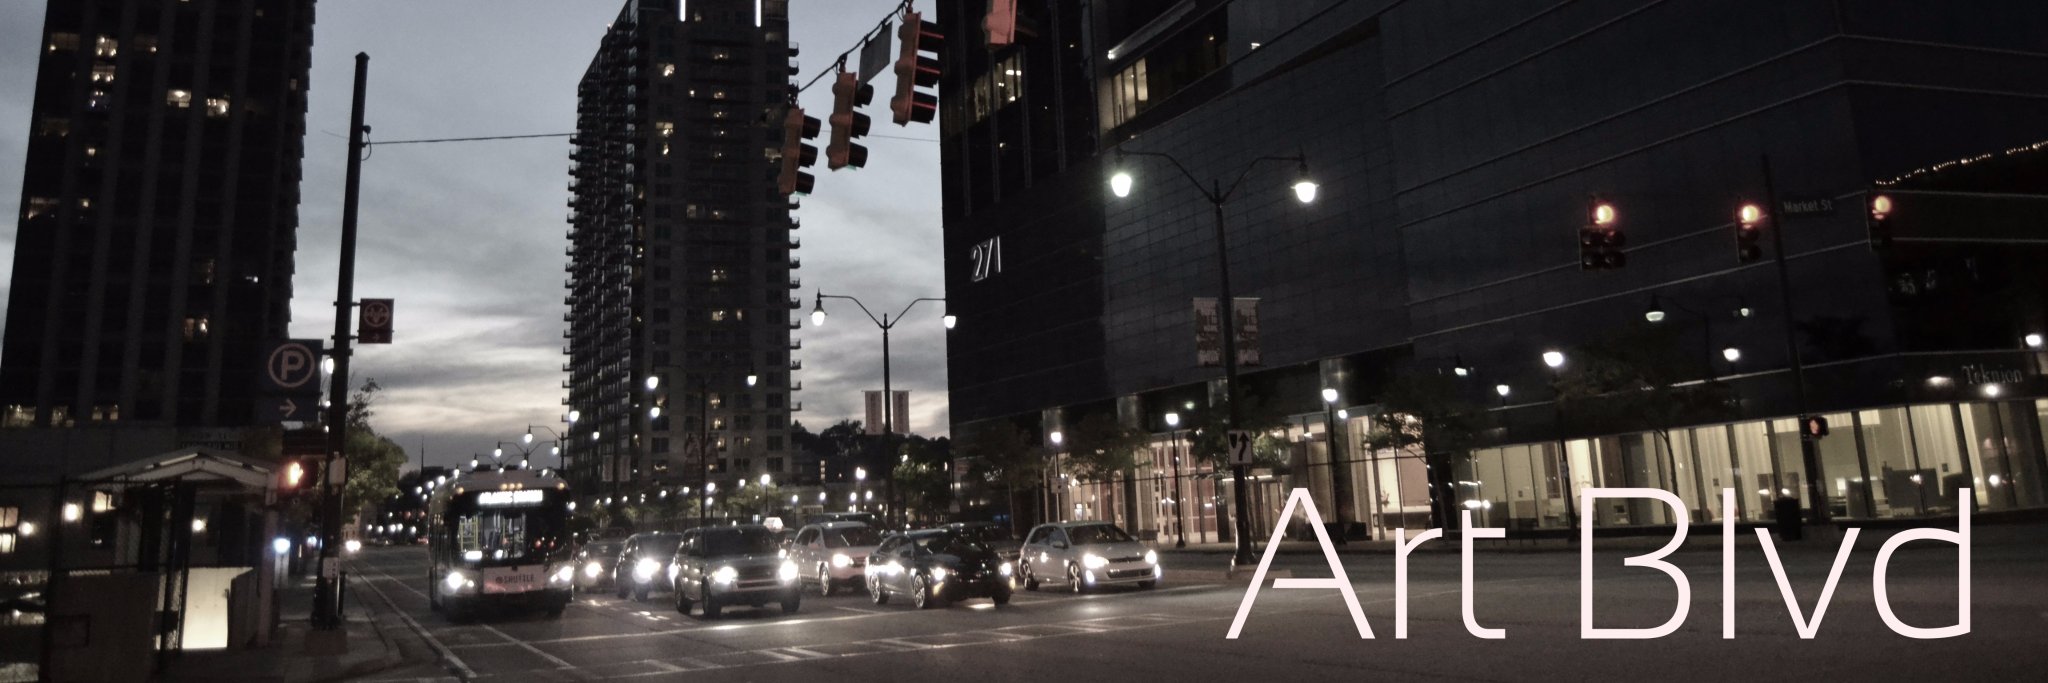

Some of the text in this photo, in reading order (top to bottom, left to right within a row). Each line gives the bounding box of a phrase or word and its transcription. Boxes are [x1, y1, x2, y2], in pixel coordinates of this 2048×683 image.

[1783, 198, 1833, 213] Market St
[970, 235, 1001, 282] 271
[281, 350, 304, 381] P
[1961, 363, 2023, 384] Teknion
